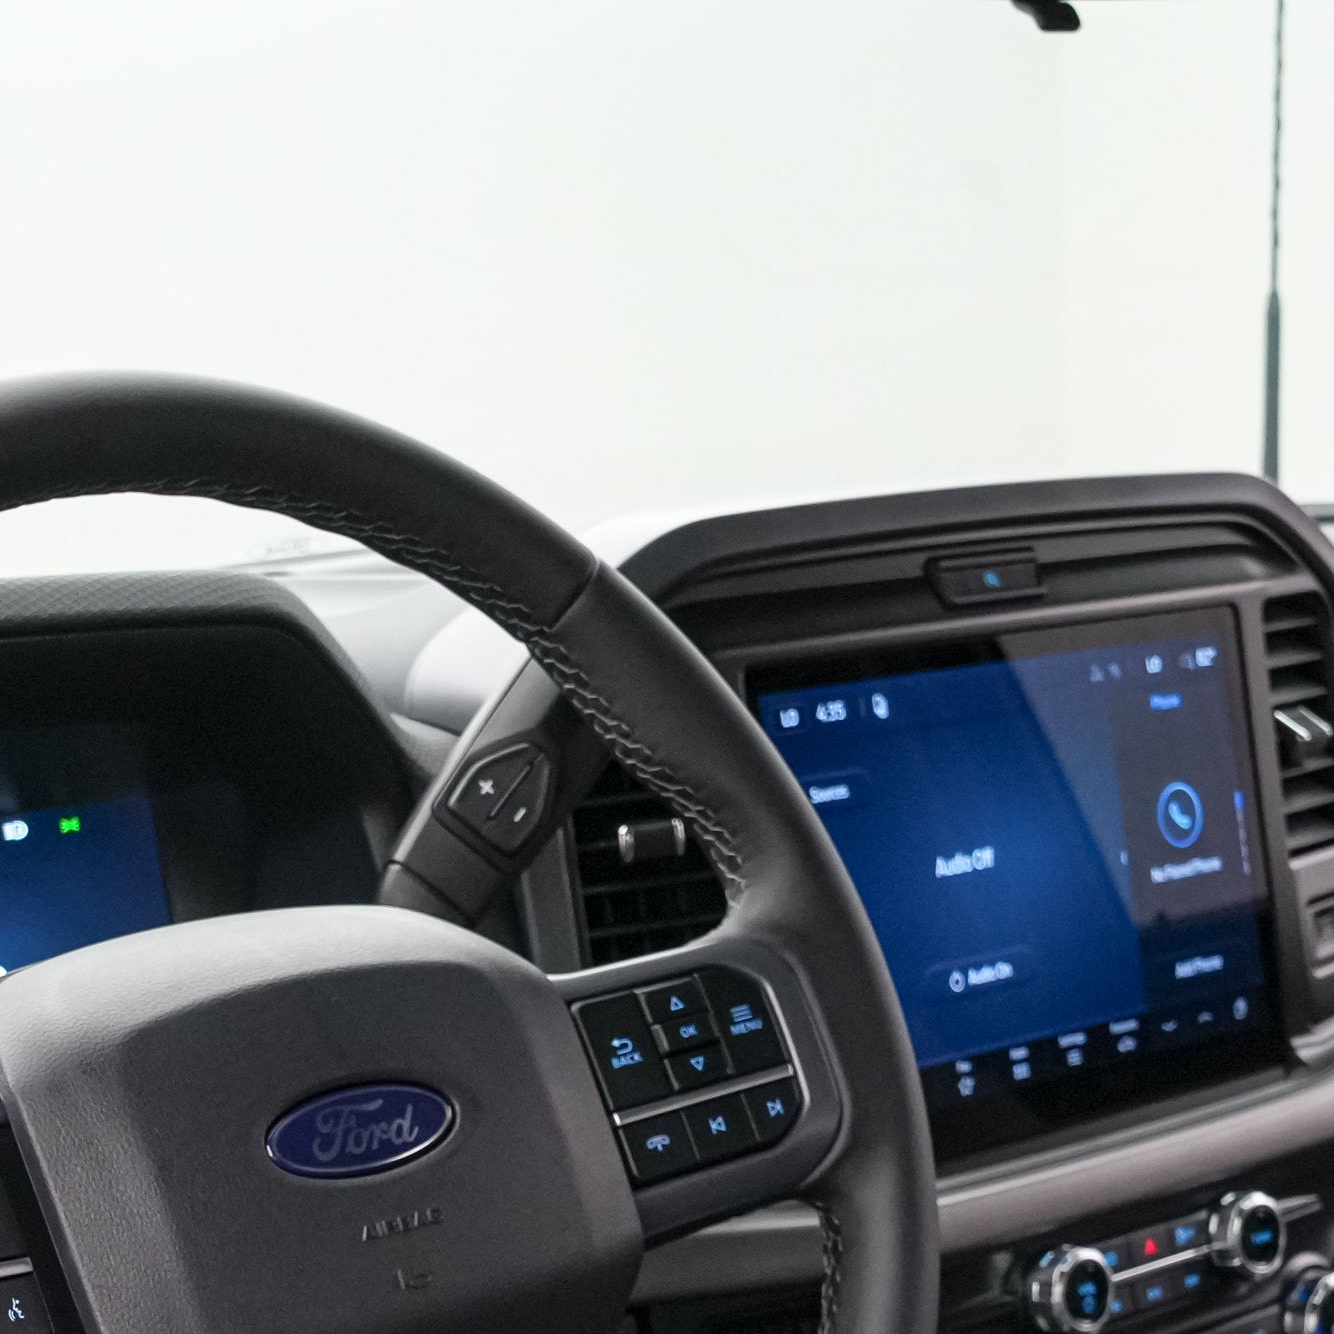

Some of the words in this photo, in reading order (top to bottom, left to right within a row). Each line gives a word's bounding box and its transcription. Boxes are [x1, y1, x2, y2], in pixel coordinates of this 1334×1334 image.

[679, 1023, 698, 1039] OK
[730, 1018, 763, 1036] MENU
[611, 1051, 643, 1069] BACK
[312, 1098, 419, 1162] Ford
